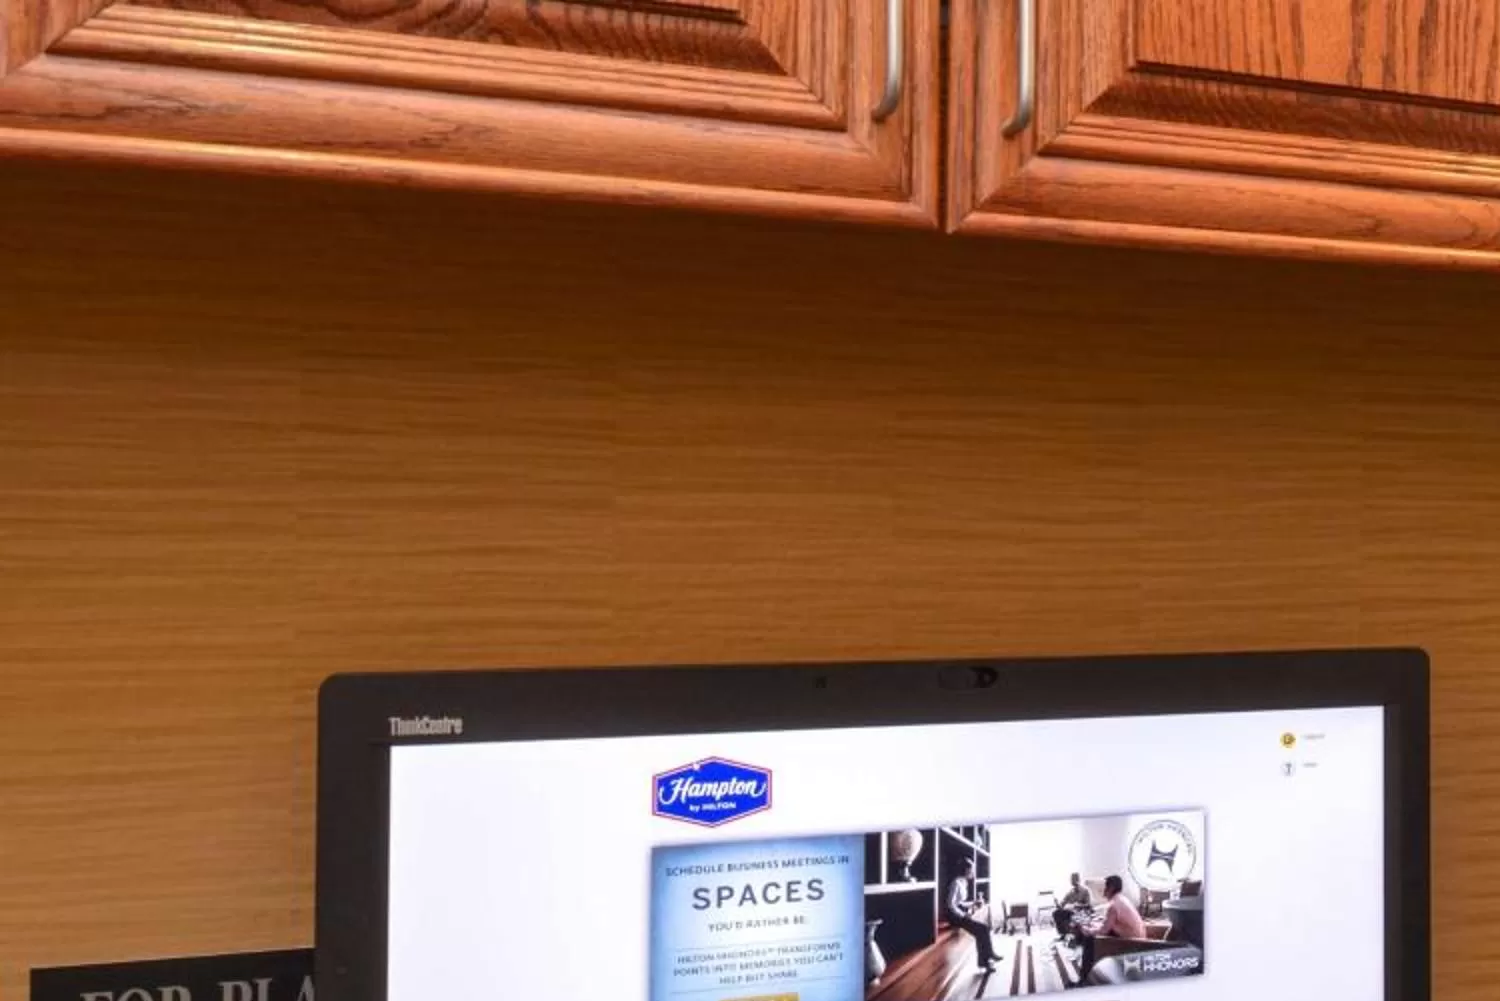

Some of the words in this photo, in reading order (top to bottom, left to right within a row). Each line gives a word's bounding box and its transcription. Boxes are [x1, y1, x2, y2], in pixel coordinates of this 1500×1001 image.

[659, 776, 767, 805] Hampton
[664, 862, 724, 878] SCHEDULE
[727, 859, 780, 872] BUSINESS
[781, 855, 835, 869] MEETINGS
[837, 854, 850, 865] IN
[691, 877, 826, 911] SPACES
[746, 916, 790, 929] RATHER
